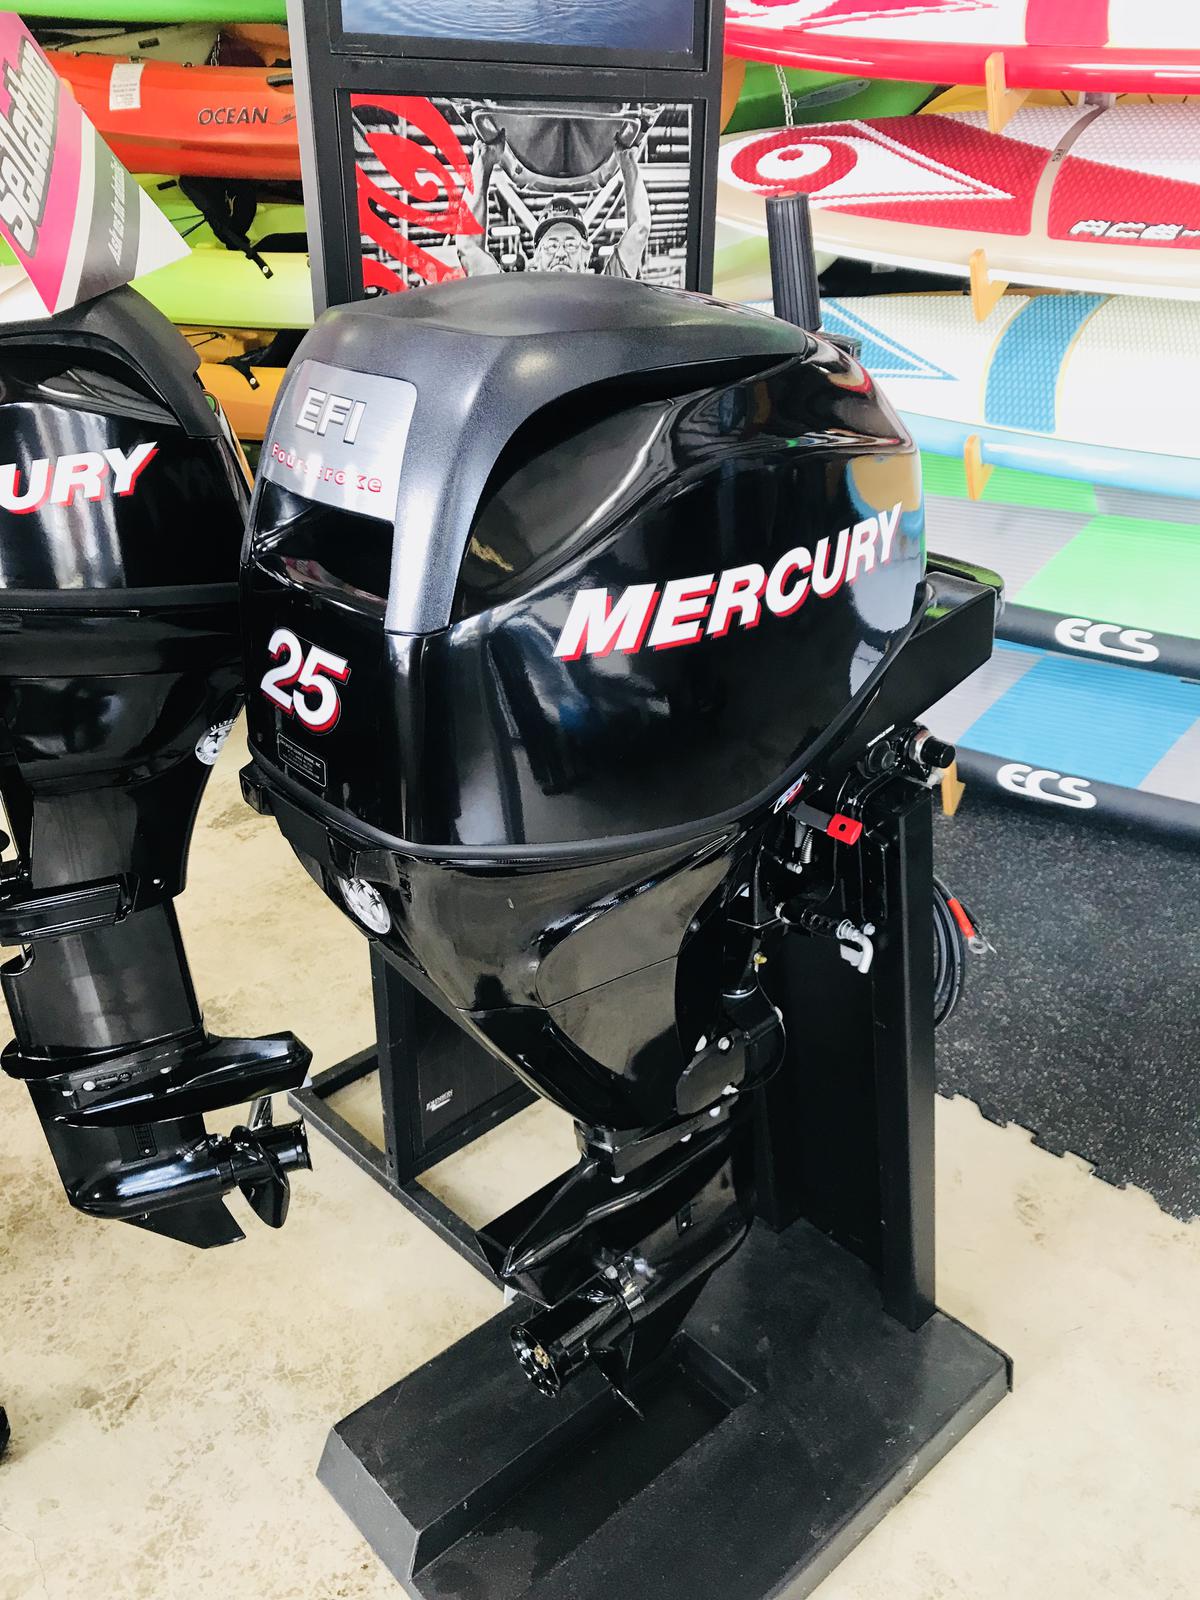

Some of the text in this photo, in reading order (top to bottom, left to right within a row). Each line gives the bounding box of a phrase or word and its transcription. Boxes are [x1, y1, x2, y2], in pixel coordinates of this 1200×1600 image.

[197, 106, 269, 125] OCEAN
[0, 38, 58, 255] Sellathon
[296, 387, 367, 445] EFI
[552, 501, 903, 662] MERCURY
[1054, 617, 1160, 662] ECS
[259, 627, 350, 733] 25
[996, 763, 1097, 809] ECS
